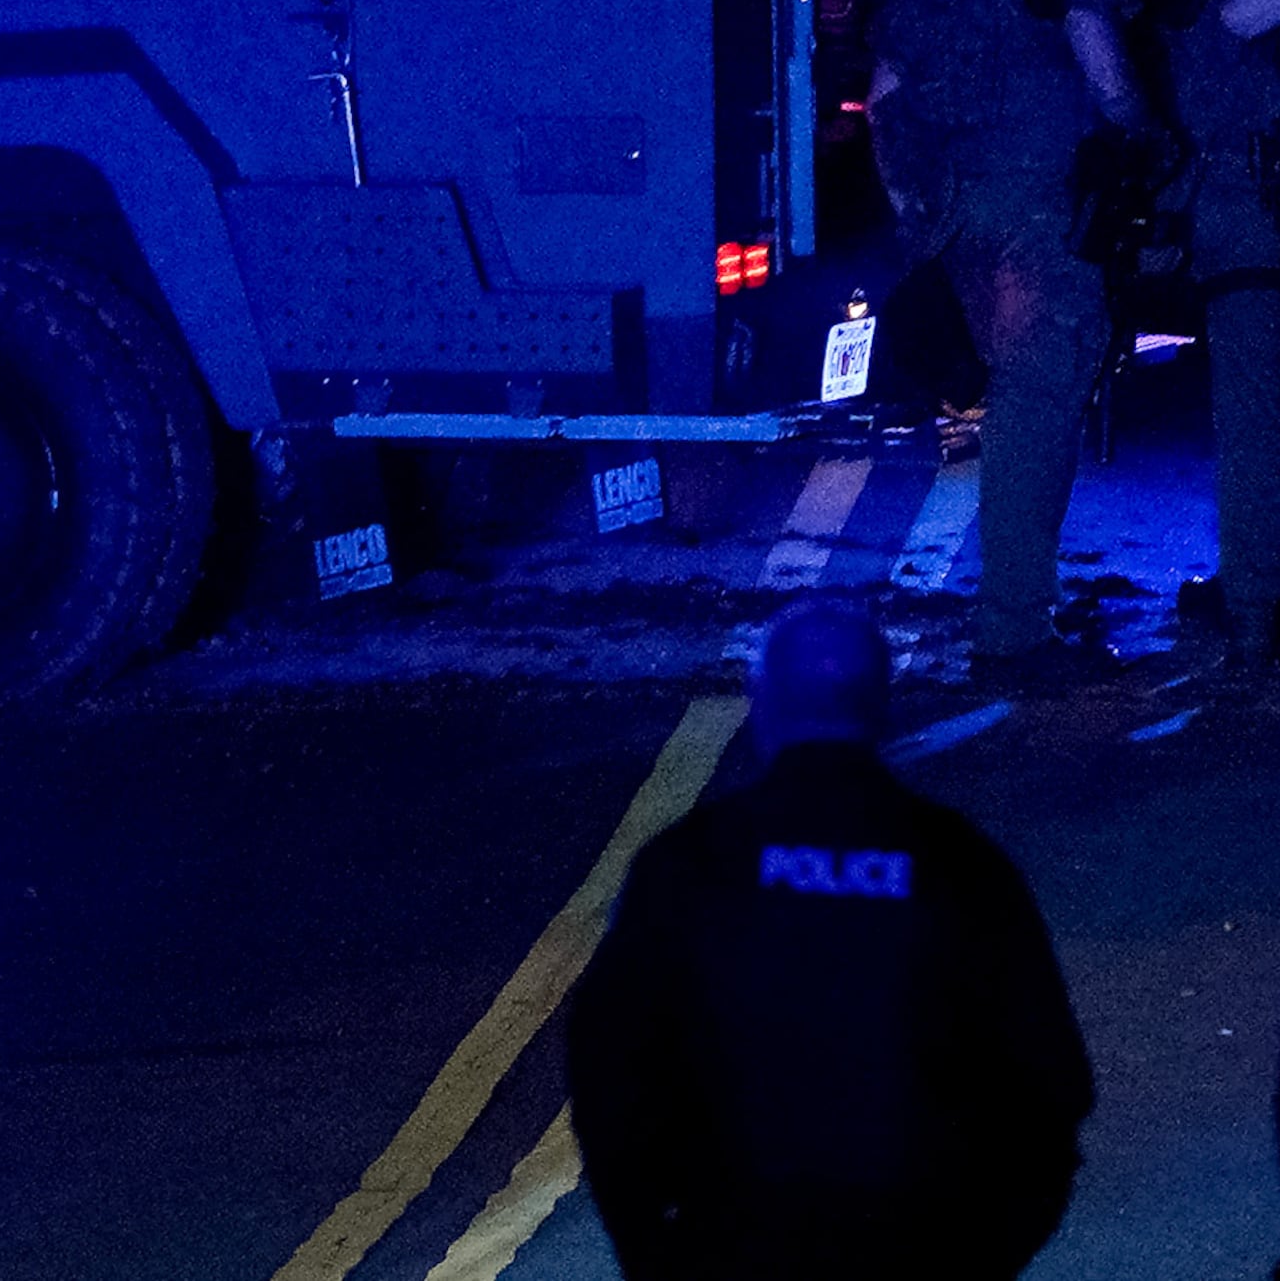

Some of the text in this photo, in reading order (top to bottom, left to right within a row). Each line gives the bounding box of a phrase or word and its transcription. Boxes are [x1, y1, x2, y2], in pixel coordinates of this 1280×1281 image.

[592, 457, 662, 513] LENCO
[313, 523, 388, 578] LENCO
[761, 845, 911, 898] POLICE
